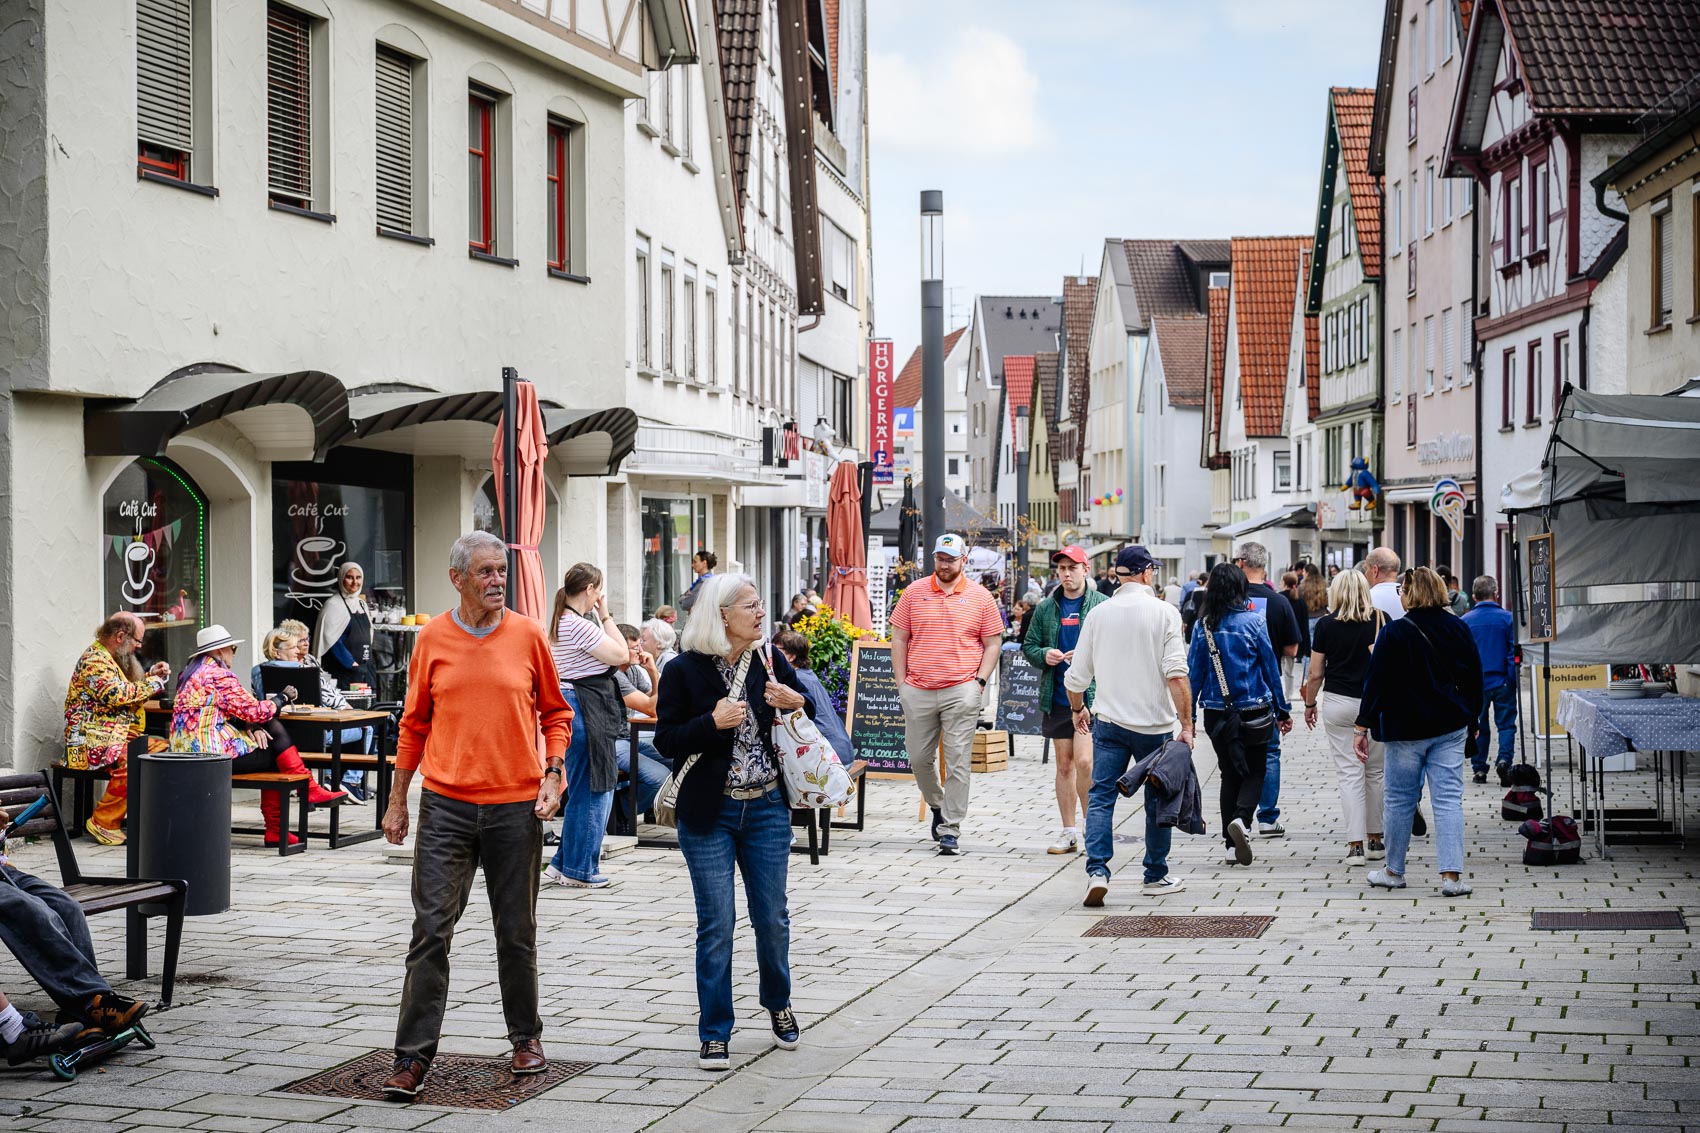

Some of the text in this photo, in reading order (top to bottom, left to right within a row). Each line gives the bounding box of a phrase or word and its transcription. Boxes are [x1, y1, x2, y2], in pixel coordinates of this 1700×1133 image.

[875, 343, 889, 466] HÖRGERÄTE
[120, 499, 157, 517] Café Cut
[287, 502, 350, 517] Café Cut
[875, 748, 899, 759] COOLE
